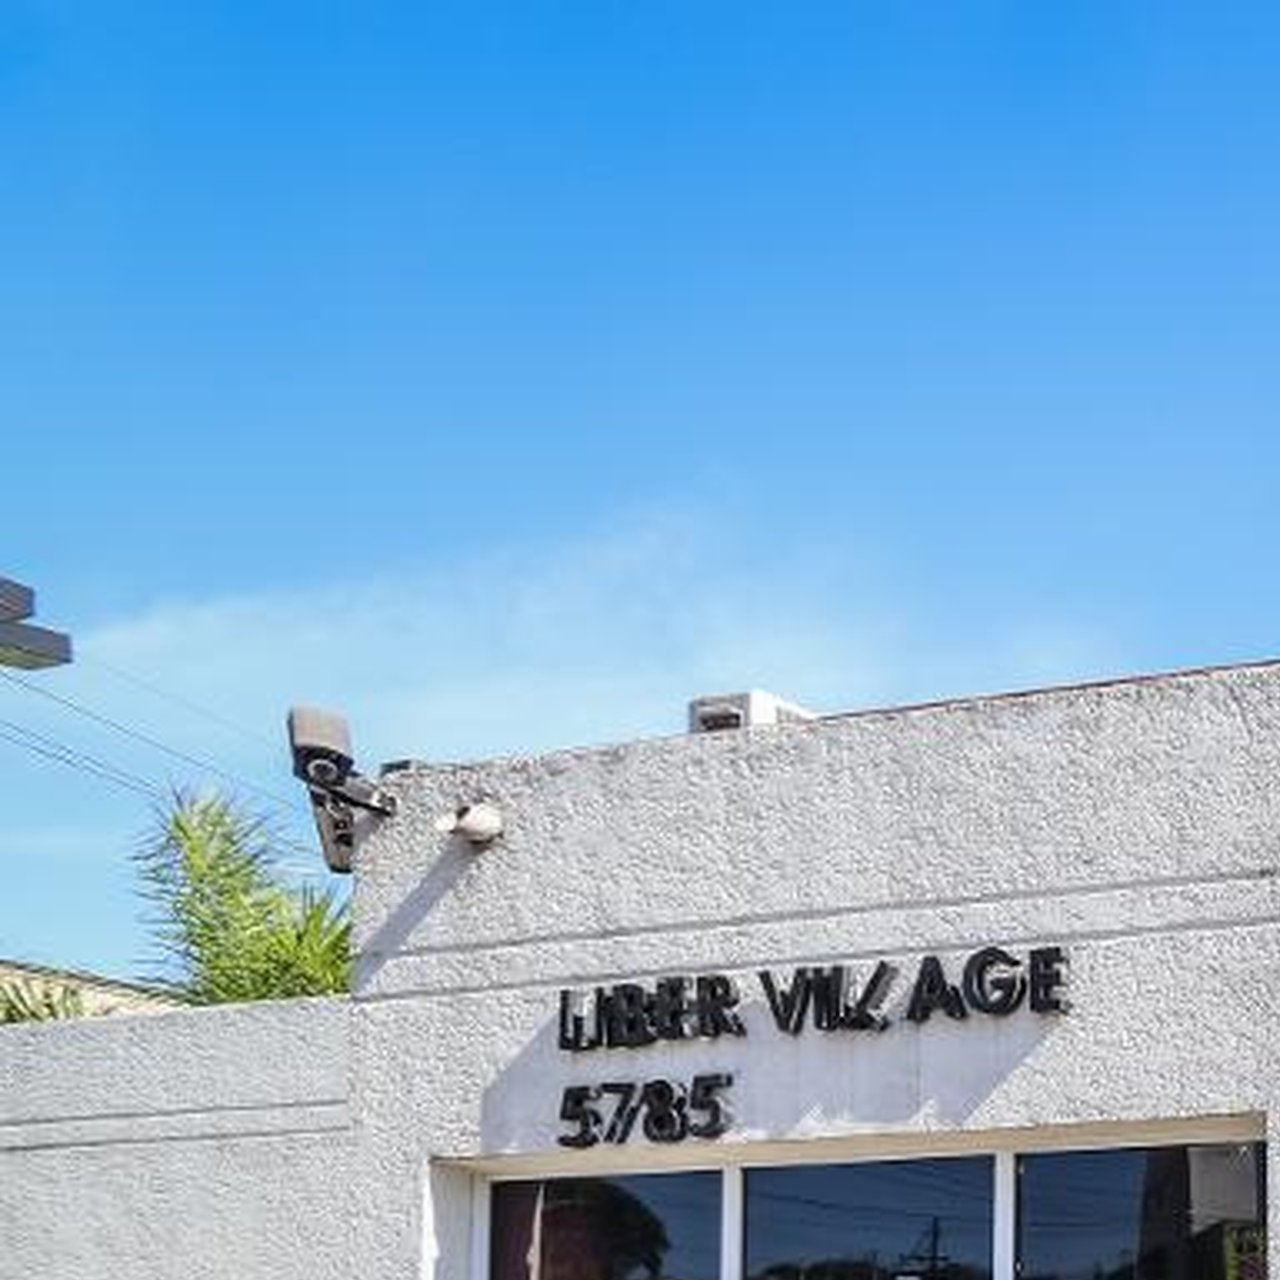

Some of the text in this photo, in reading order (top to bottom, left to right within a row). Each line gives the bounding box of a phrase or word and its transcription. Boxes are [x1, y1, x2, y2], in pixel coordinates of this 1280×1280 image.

[558, 946, 1068, 1051] LIBER VILLAGE
[558, 1072, 733, 1148] 5785
